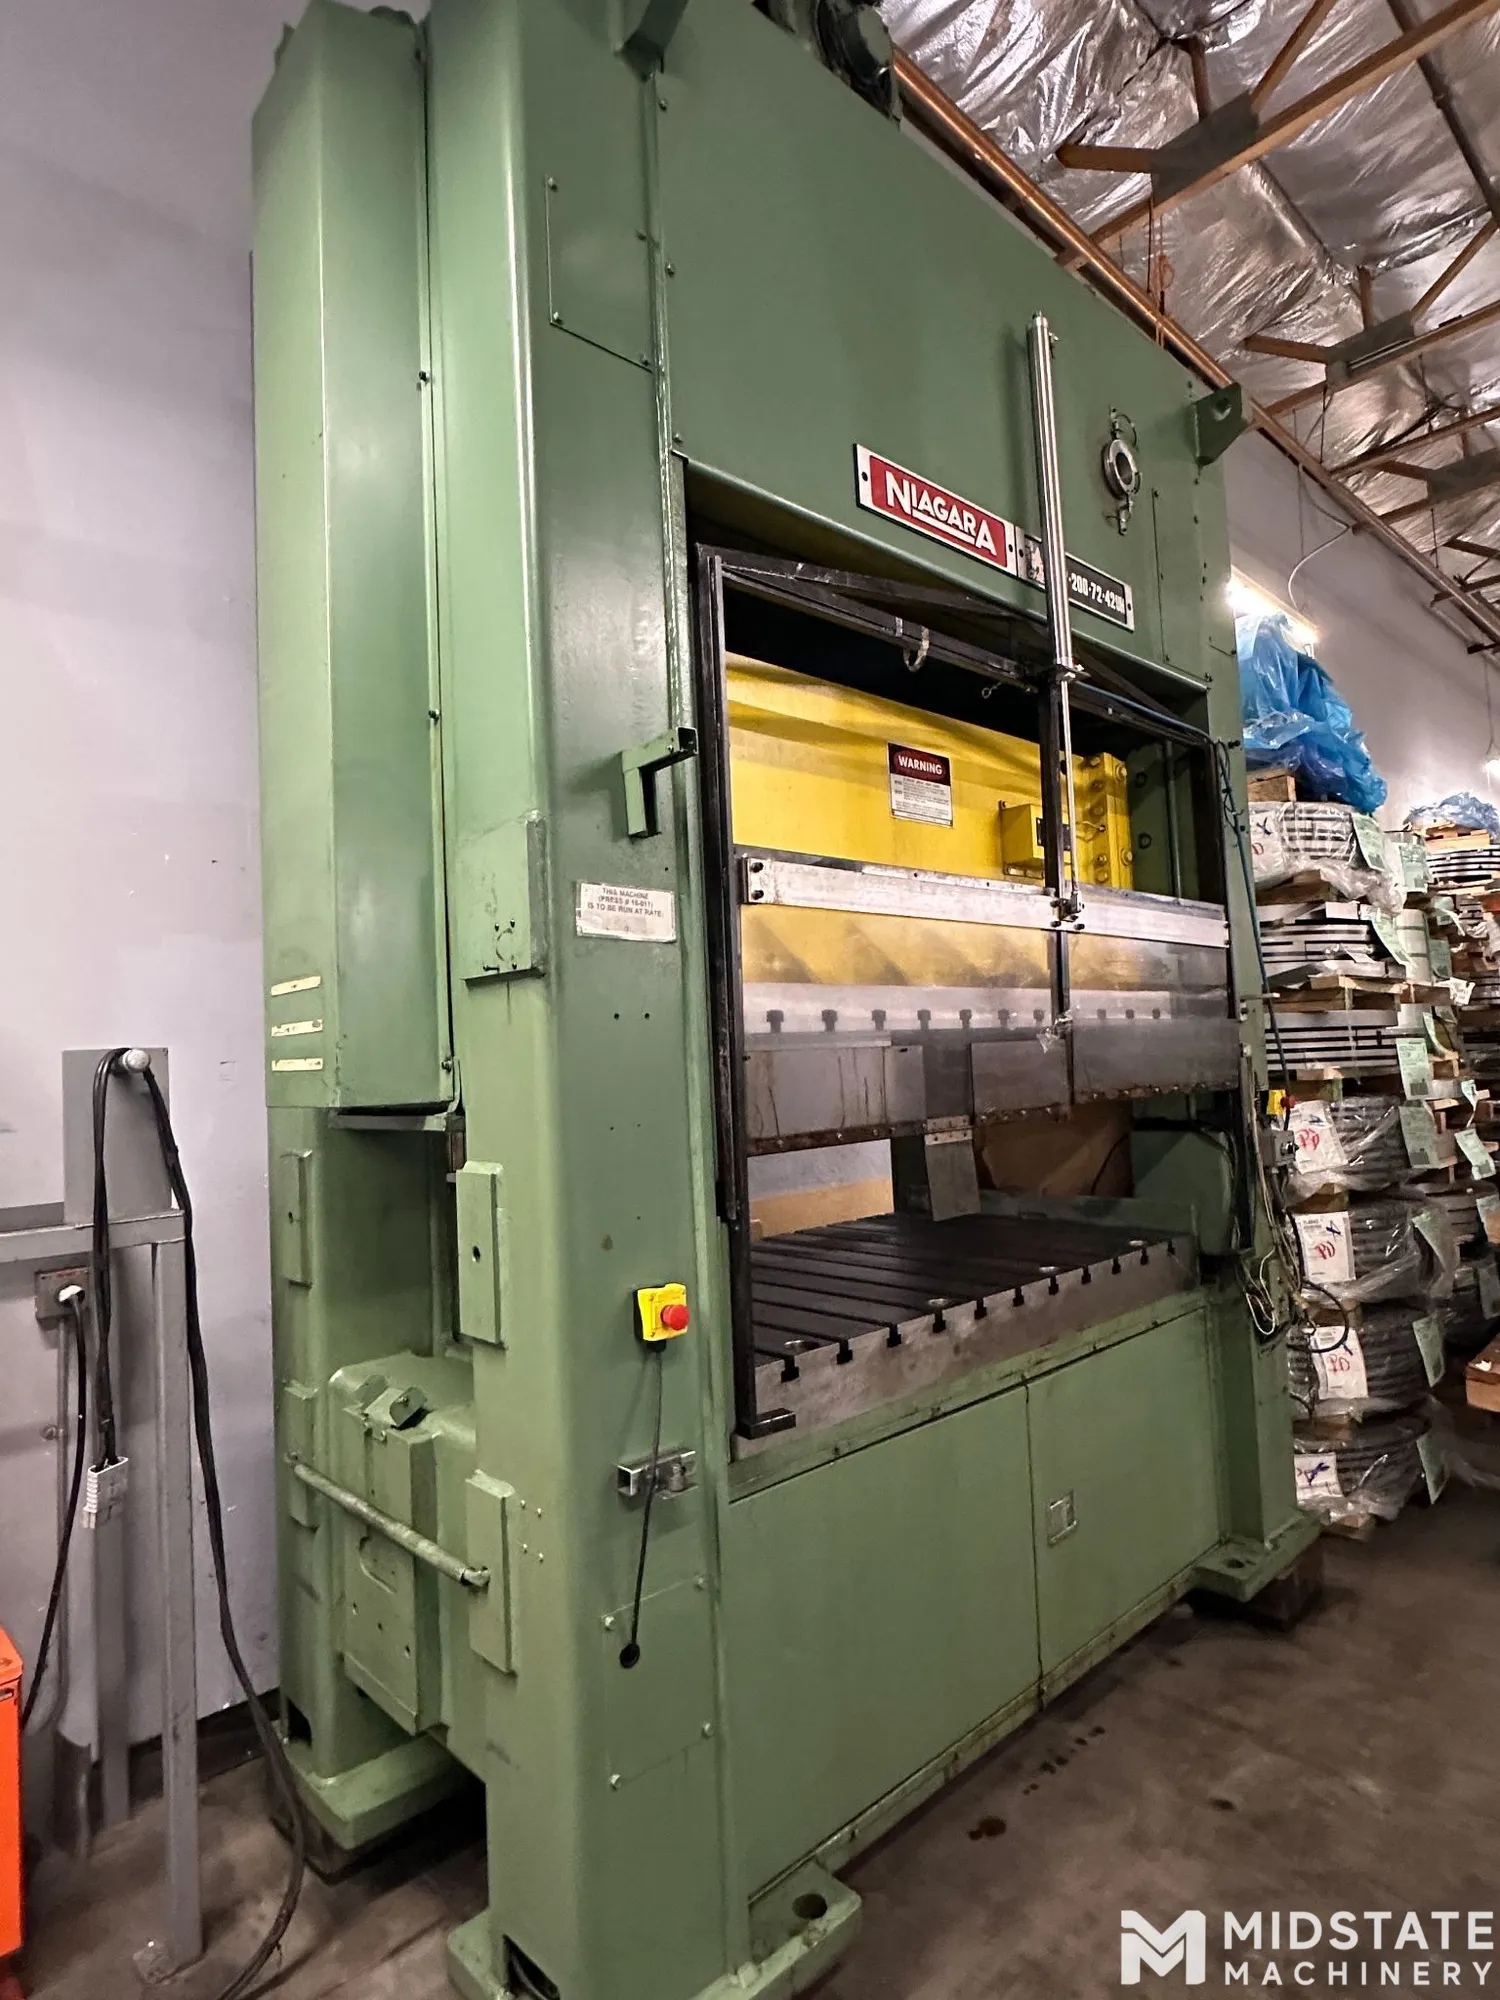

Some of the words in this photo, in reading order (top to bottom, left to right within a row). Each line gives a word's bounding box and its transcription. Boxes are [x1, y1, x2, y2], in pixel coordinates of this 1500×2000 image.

[886, 471, 997, 557] NIAGARA
[898, 755, 943, 775] WARNING
[619, 890, 649, 899] MACHINE
[598, 895, 623, 905] (PRESS
[597, 903, 606, 911] TO
[618, 905, 633, 913] RUN
